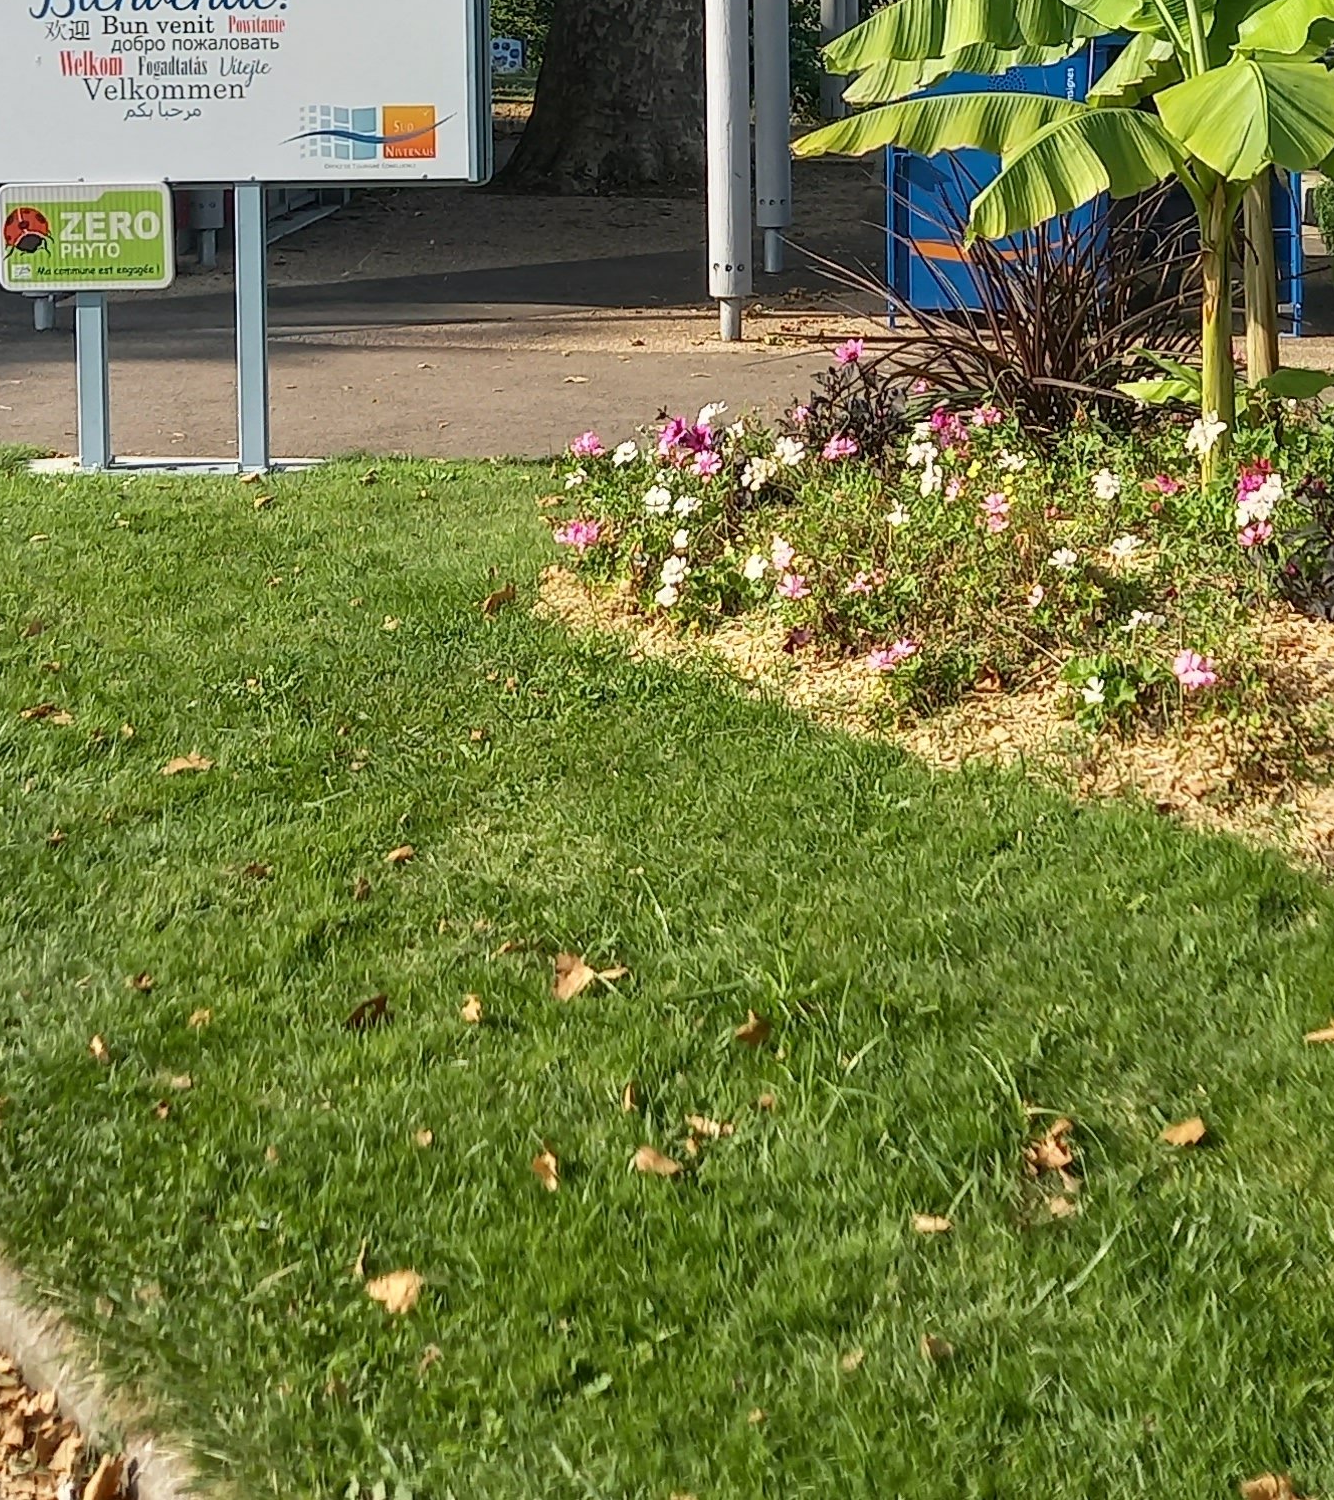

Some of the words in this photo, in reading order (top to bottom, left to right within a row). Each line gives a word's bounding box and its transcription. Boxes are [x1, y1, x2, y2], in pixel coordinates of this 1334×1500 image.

[44, 19, 91, 41] 欢迎
[101, 15, 148, 34] Bun
[156, 14, 215, 34] venit
[228, 15, 286, 33] Powitanie
[111, 36, 166, 54] добро
[172, 35, 280, 50] пожаловать
[60, 51, 123, 76] Welkom
[138, 55, 208, 79] Fogadtatás
[83, 78, 247, 100] Velkommen
[123, 102, 154, 121] بكم
[158, 101, 202, 121] مرحبا
[385, 145, 435, 158] NIVERNAIS
[60, 210, 160, 242] ZERO
[61, 242, 120, 259] PHYTO
[37, 265, 52, 276] Ma
[53, 266, 95, 276] commune
[98, 265, 113, 275] est
[116, 264, 154, 278] engagée
